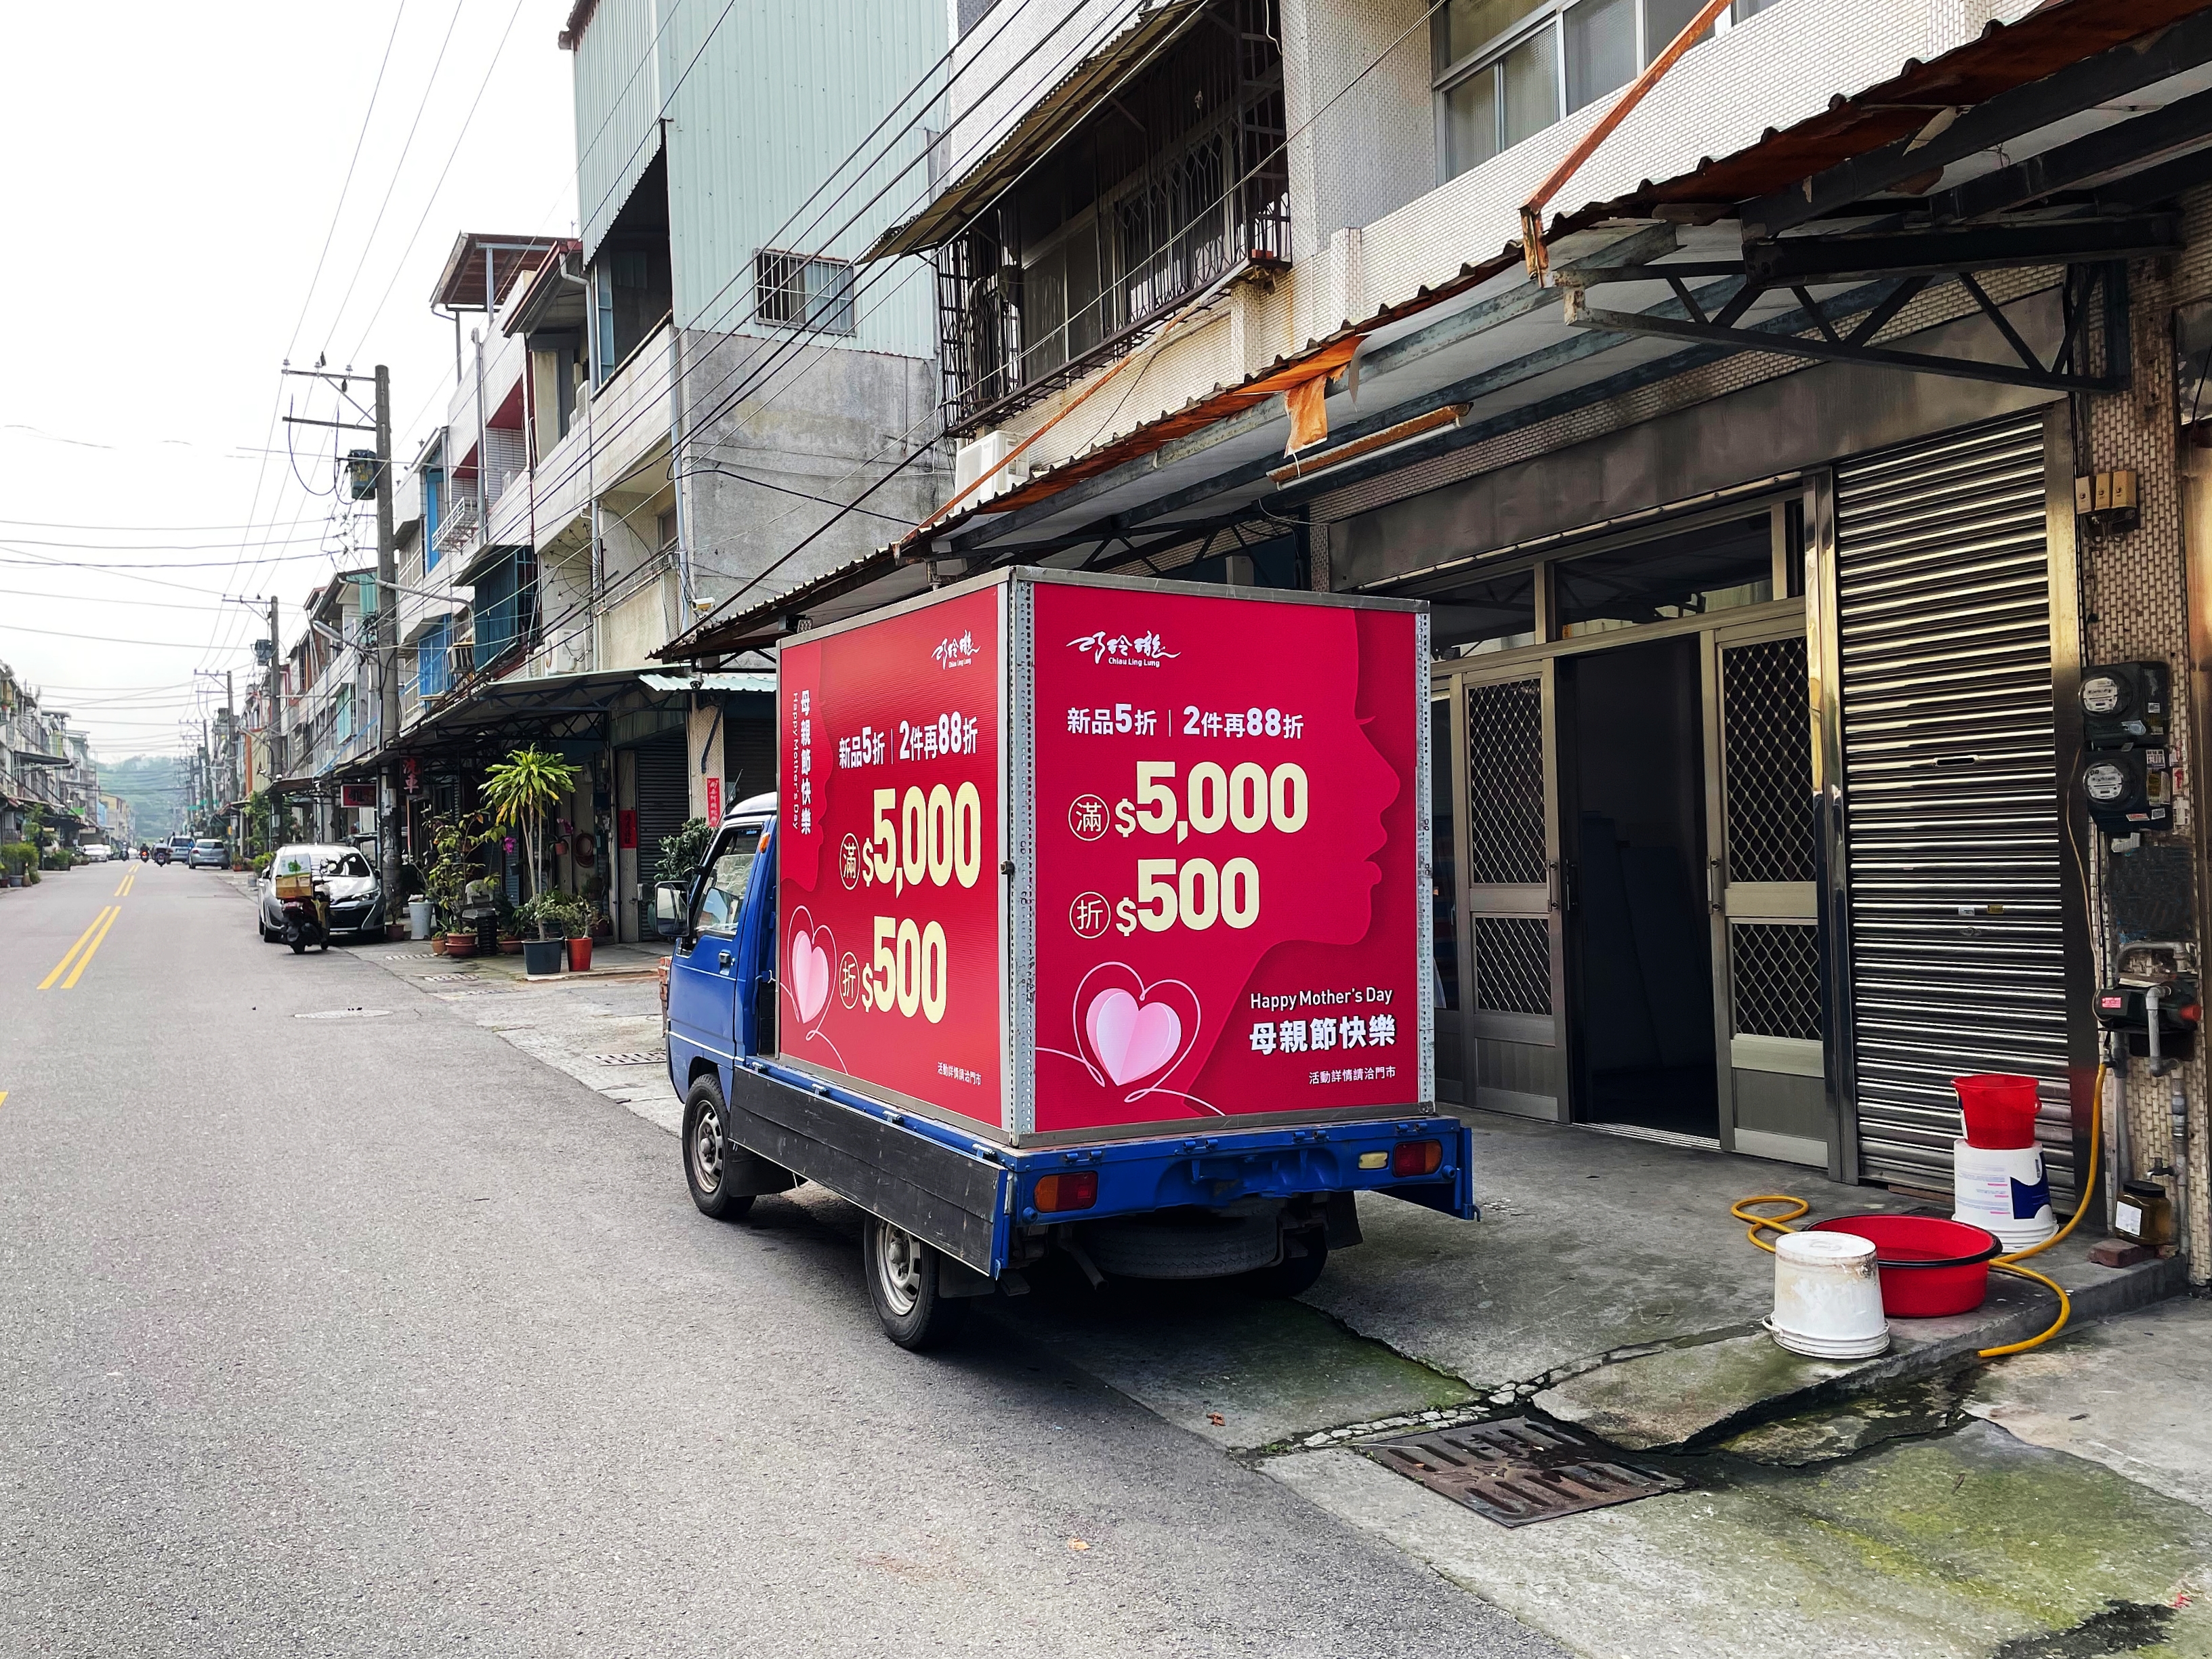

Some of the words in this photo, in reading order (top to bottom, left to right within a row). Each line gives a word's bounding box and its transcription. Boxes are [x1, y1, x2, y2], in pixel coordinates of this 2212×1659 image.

[1128, 658, 1143, 667] Ling
[1144, 659, 1160, 668] Lung
[838, 726, 885, 770] 新品5折
[898, 711, 978, 761] 2件再88折
[1067, 703, 1157, 736] 新品5折
[1183, 705, 1304, 739] 2件再88折
[800, 689, 812, 835] 母親節快樂
[1114, 761, 1308, 845] $5,000
[862, 781, 981, 898] $5,000
[1115, 857, 1259, 937] $500
[861, 915, 947, 1024] $500
[1251, 992, 1297, 1011] Happy
[1299, 988, 1363, 1006] Mother's
[1366, 986, 1393, 1005] Day
[1249, 1013, 1396, 1055] 母親節快樂
[937, 1061, 982, 1086] 活動詳情請洽門市
[1309, 1066, 1396, 1085] 活動詳情請洽門市
